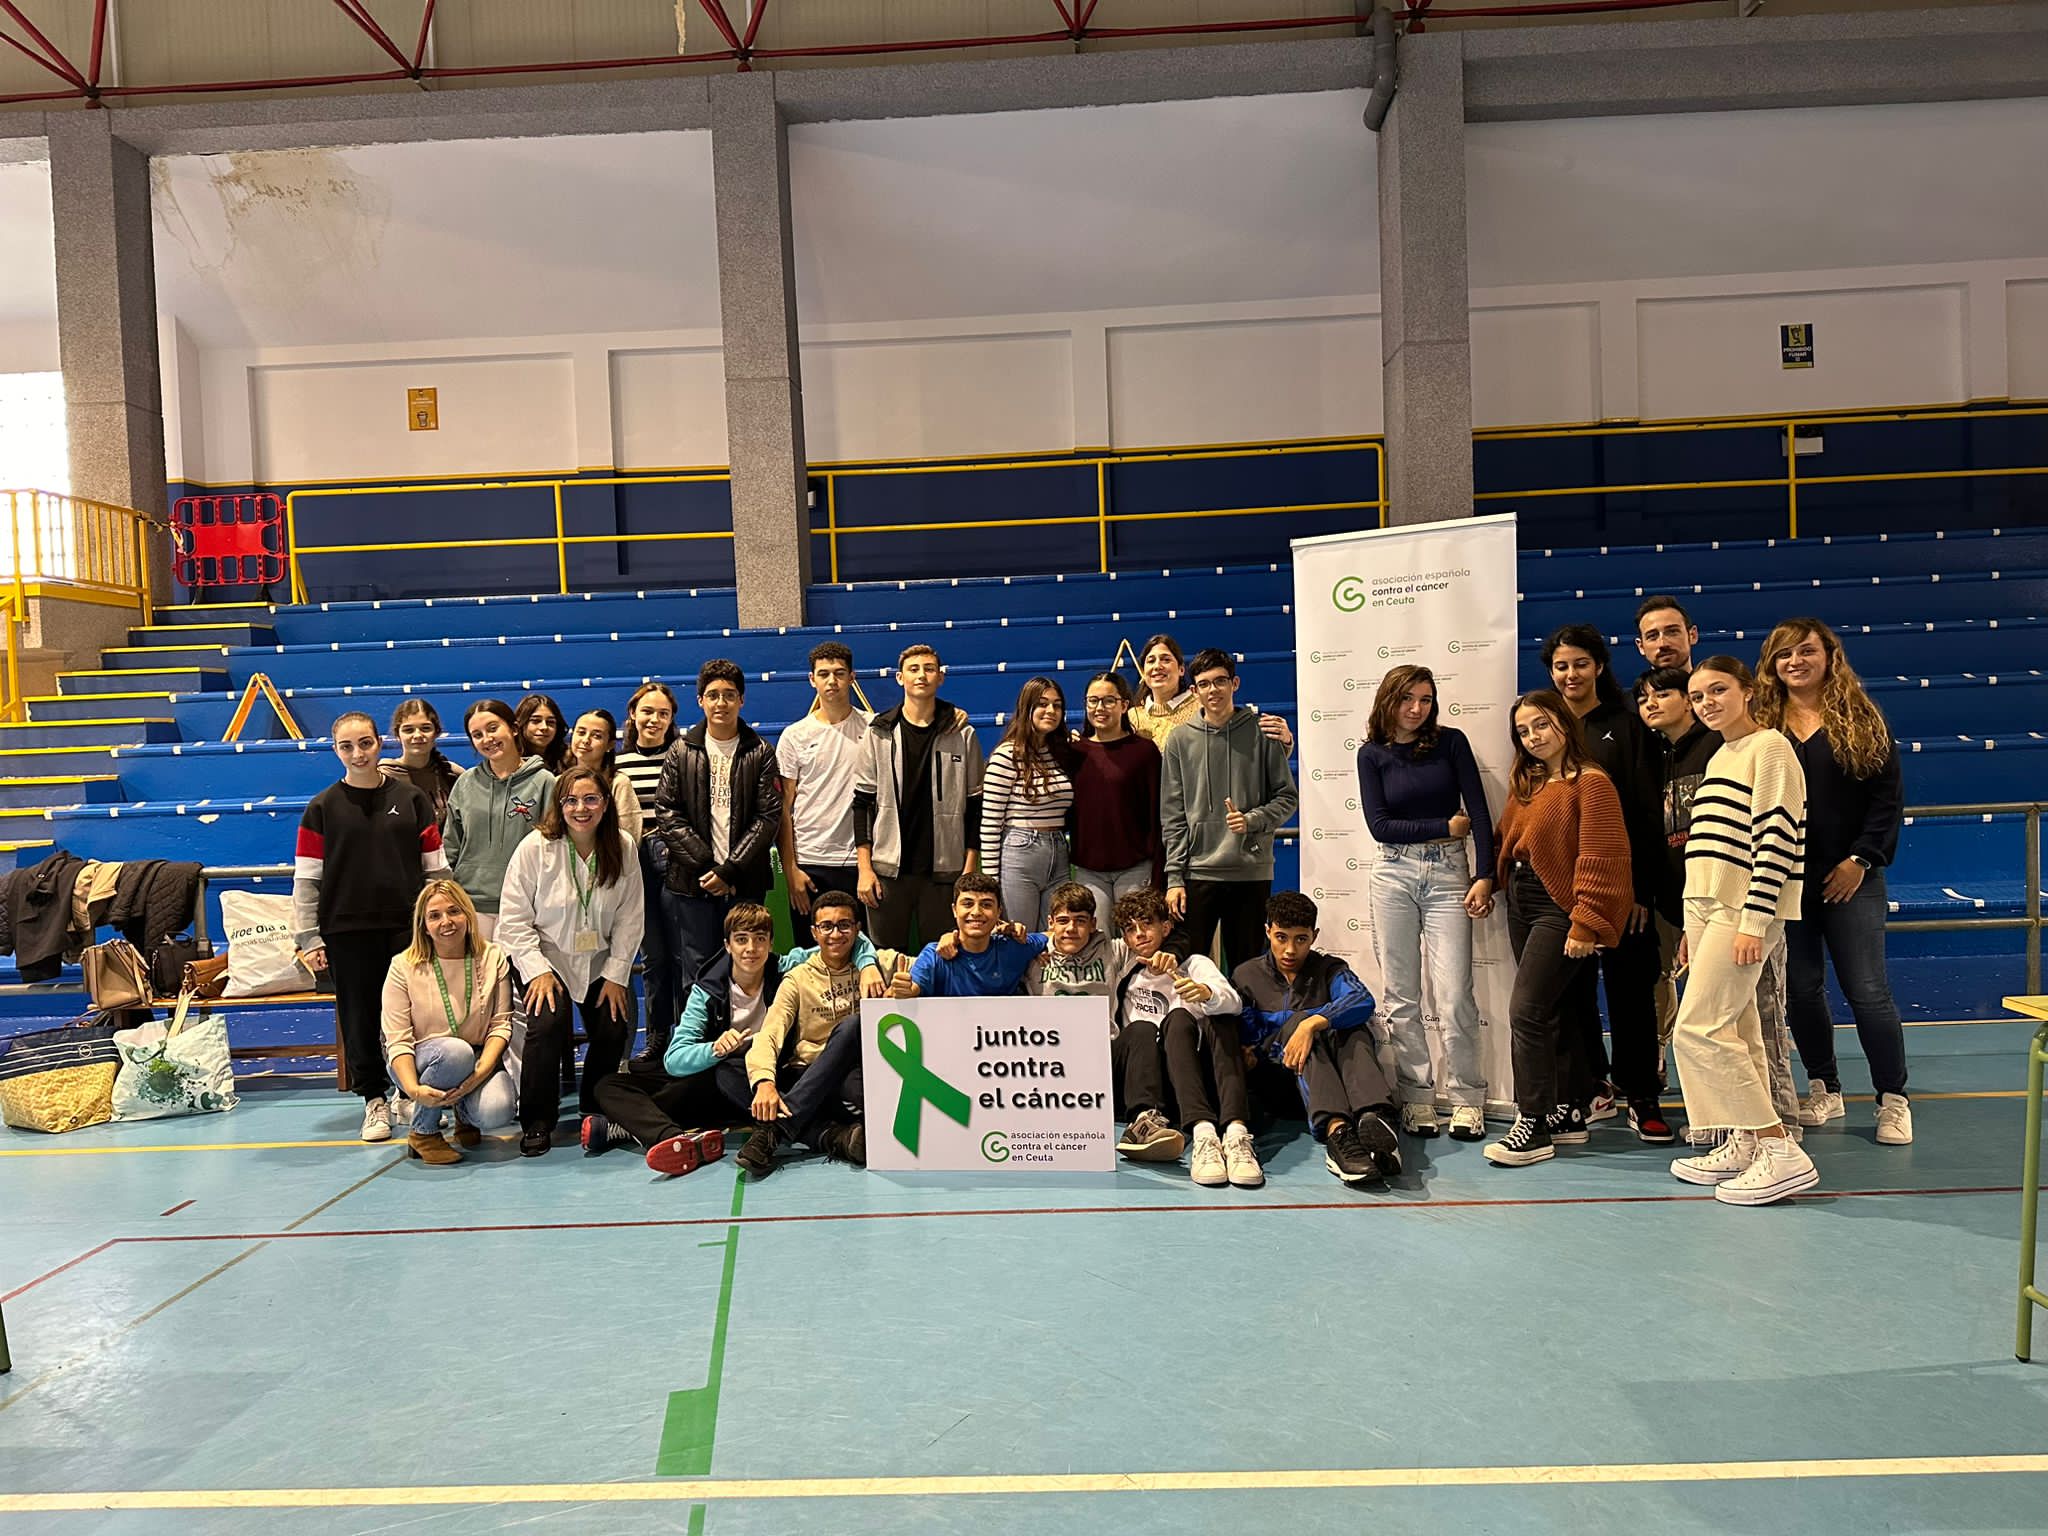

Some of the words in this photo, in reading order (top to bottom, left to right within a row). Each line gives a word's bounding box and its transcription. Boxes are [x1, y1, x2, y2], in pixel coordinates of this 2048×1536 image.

[1371, 572, 1423, 586] asociación
[1425, 568, 1471, 581] española
[1371, 586, 1403, 597] contra
[1405, 584, 1414, 593] el
[1415, 581, 1449, 592] cáncer
[1386, 596, 1415, 606] Ceuta
[974, 1026, 1060, 1051] juntos
[977, 1057, 1066, 1078] contra
[979, 1087, 1005, 1109] el
[1012, 1086, 1106, 1109] cáncer
[1010, 1130, 1060, 1139] asociación
[1062, 1131, 1106, 1140] española
[1011, 1142, 1041, 1151] contra
[1043, 1142, 1053, 1150] el
[1025, 1153, 1054, 1161] Ceuta
